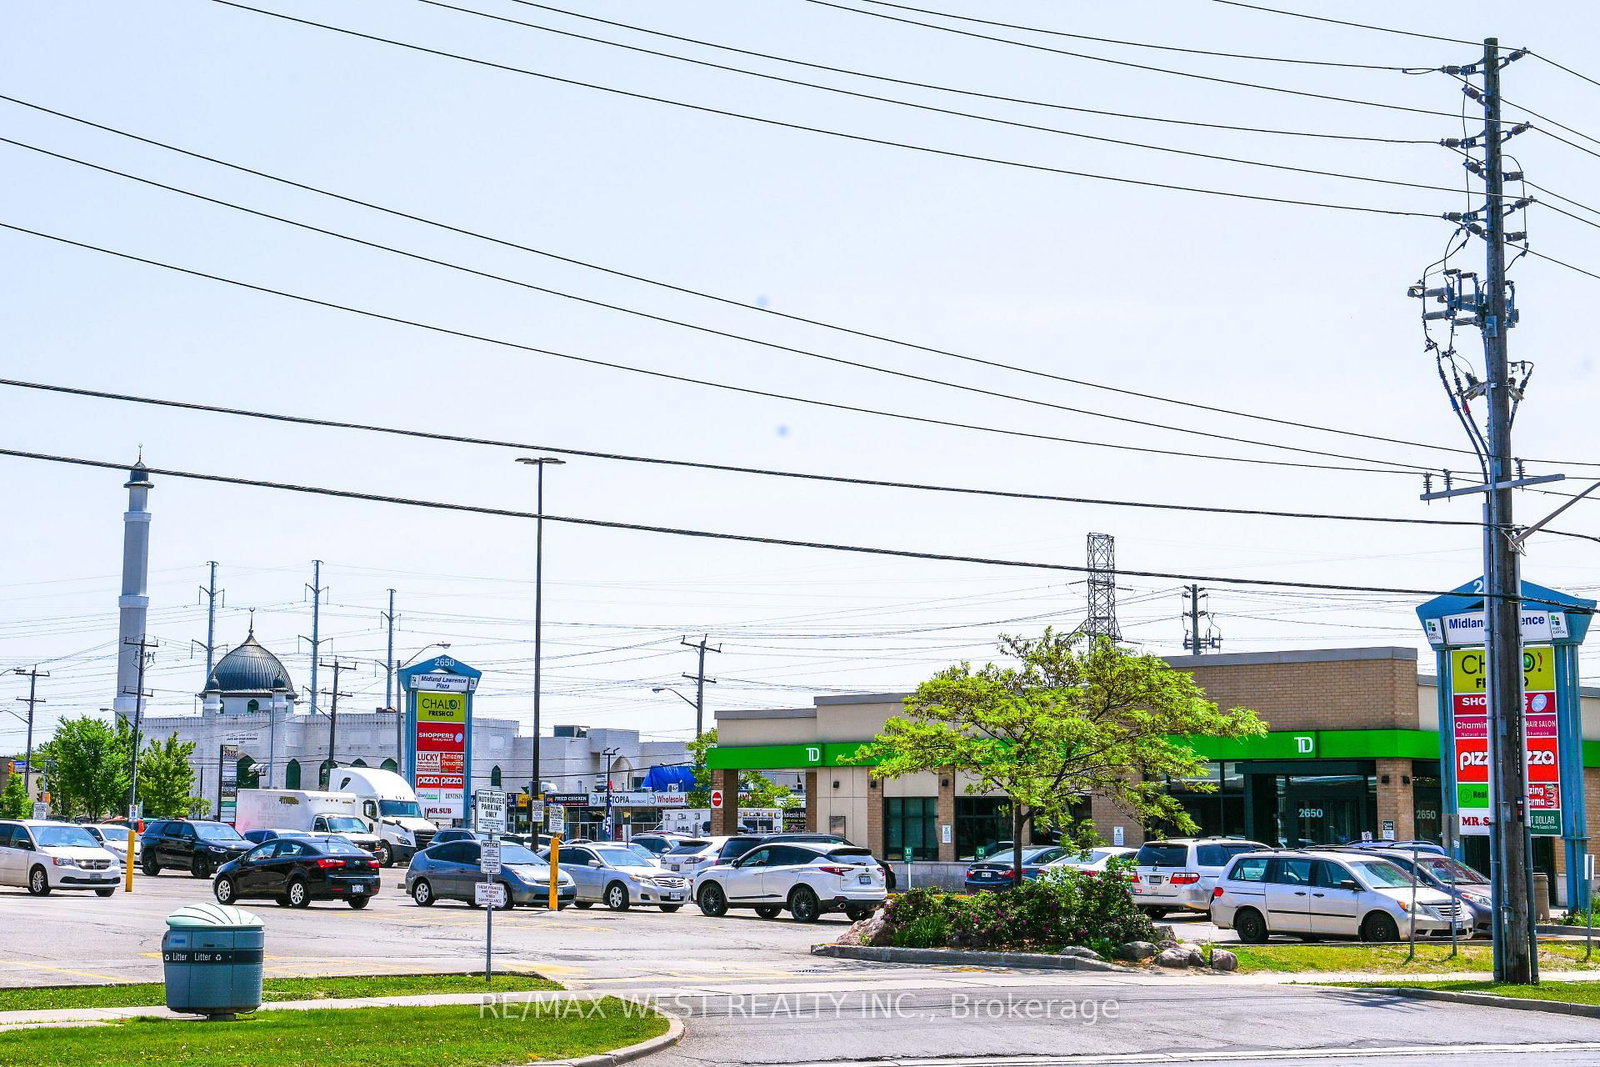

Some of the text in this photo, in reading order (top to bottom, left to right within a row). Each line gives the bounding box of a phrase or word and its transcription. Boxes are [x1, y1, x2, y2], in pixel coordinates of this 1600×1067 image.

[1449, 614, 1545, 629] Midlan ence
[434, 658, 455, 667] 2650
[1455, 721, 1488, 730] Charmin
[1538, 719, 1557, 728] SALON
[1293, 736, 1314, 753] TD
[417, 753, 439, 761] LUCKY
[805, 747, 820, 762] TD
[1459, 751, 1488, 771] pizz
[417, 776, 463, 787] pizza pizza
[1528, 785, 1545, 796] zing
[478, 796, 505, 805] AUTHORIZED
[656, 795, 684, 803] Wholesale
[480, 803, 503, 811] PARKING
[485, 810, 498, 818] ONLY
[1298, 808, 1324, 818] 2650
[1416, 810, 1437, 820] 2650
[172, 952, 188, 961] Litter
[194, 952, 212, 961] Litter
